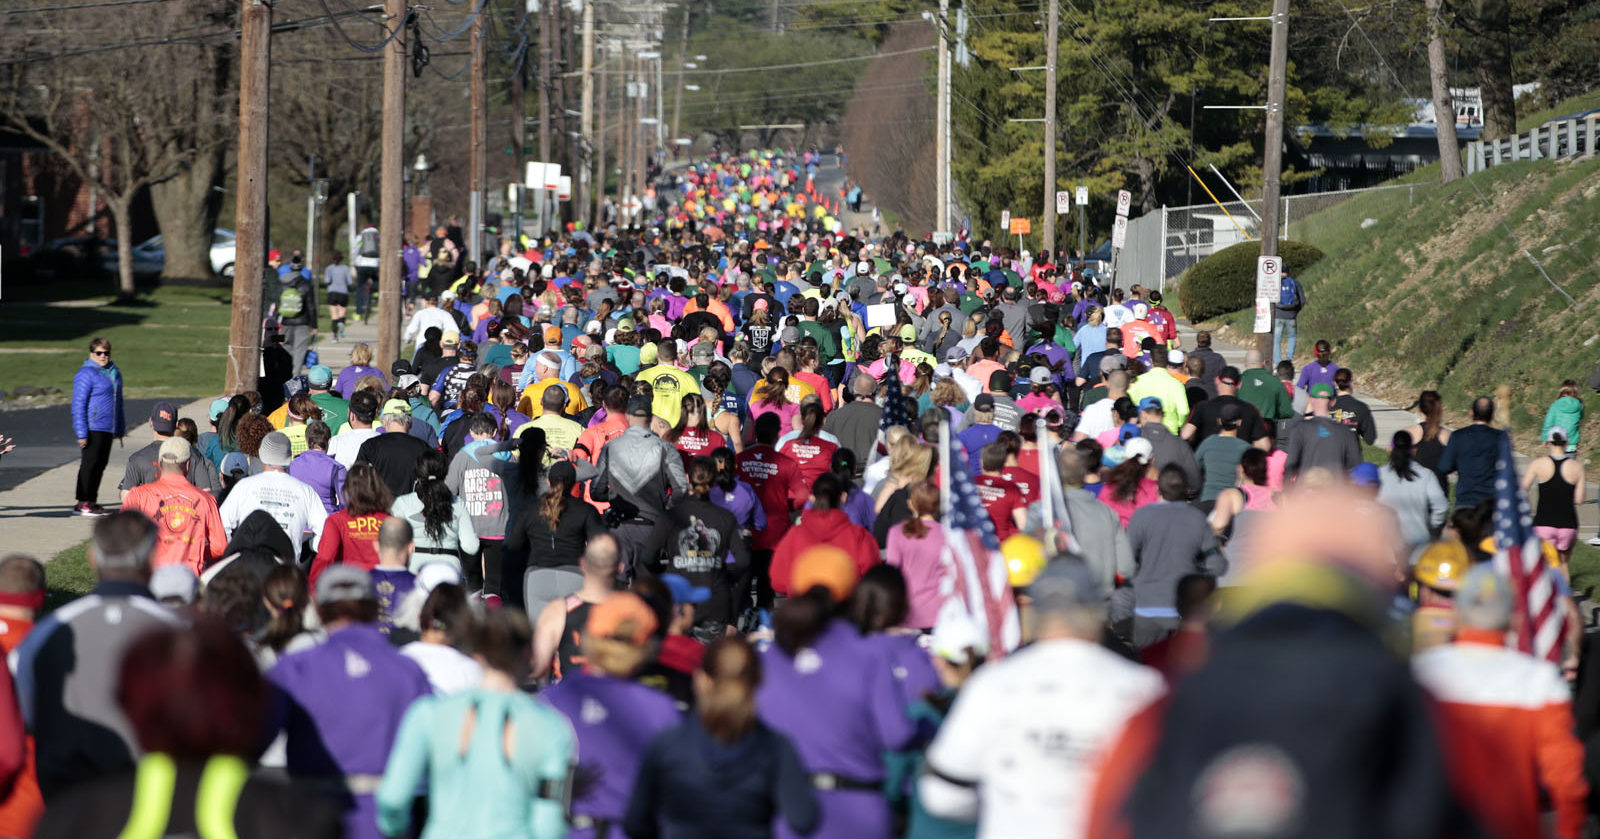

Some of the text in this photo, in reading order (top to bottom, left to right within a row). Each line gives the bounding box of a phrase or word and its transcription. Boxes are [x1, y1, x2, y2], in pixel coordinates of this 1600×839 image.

[742, 461, 778, 469] ENRICHING
[741, 466, 779, 475] VETERANS
[464, 477, 488, 493] RACE
[493, 490, 503, 501] TO
